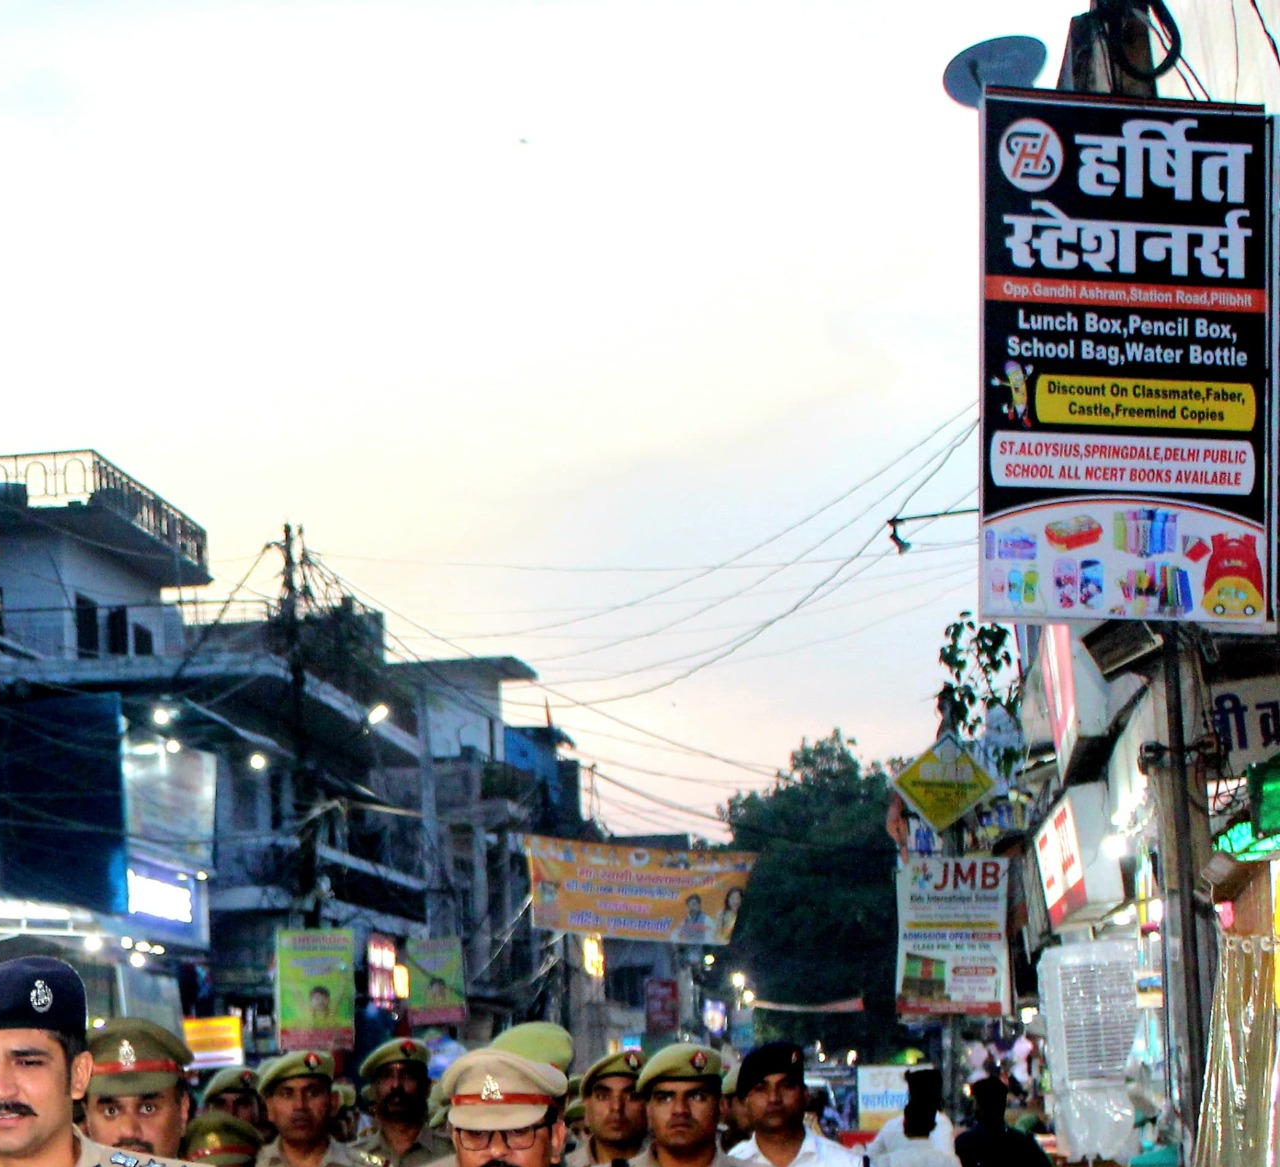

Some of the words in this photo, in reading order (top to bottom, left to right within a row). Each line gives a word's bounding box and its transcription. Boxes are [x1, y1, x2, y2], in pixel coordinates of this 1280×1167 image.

[1074, 118, 1254, 204] हर्षित
[1003, 200, 1253, 279] स्टेशनर्स
[1018, 309, 1078, 332] Lunch
[1085, 312, 1188, 338] Box,Pencil
[1195, 318, 1237, 342] Box,
[1007, 335, 1075, 359] School
[1081, 340, 1183, 366] Bag,Water
[1189, 344, 1248, 367] Bottle
[1047, 381, 1107, 398] Discount
[1110, 384, 1128, 398] On
[1181, 407, 1225, 423] Copies
[1203, 450, 1247, 465] PUBLIC
[1005, 464, 1055, 480] SCHOOL
[1058, 466, 1081, 481] ALL
[1085, 467, 1126, 482] NCERT
[1129, 468, 1172, 484] BOOKS
[1175, 470, 1242, 487] AVAILABLE
[934, 861, 1001, 892] JMB
